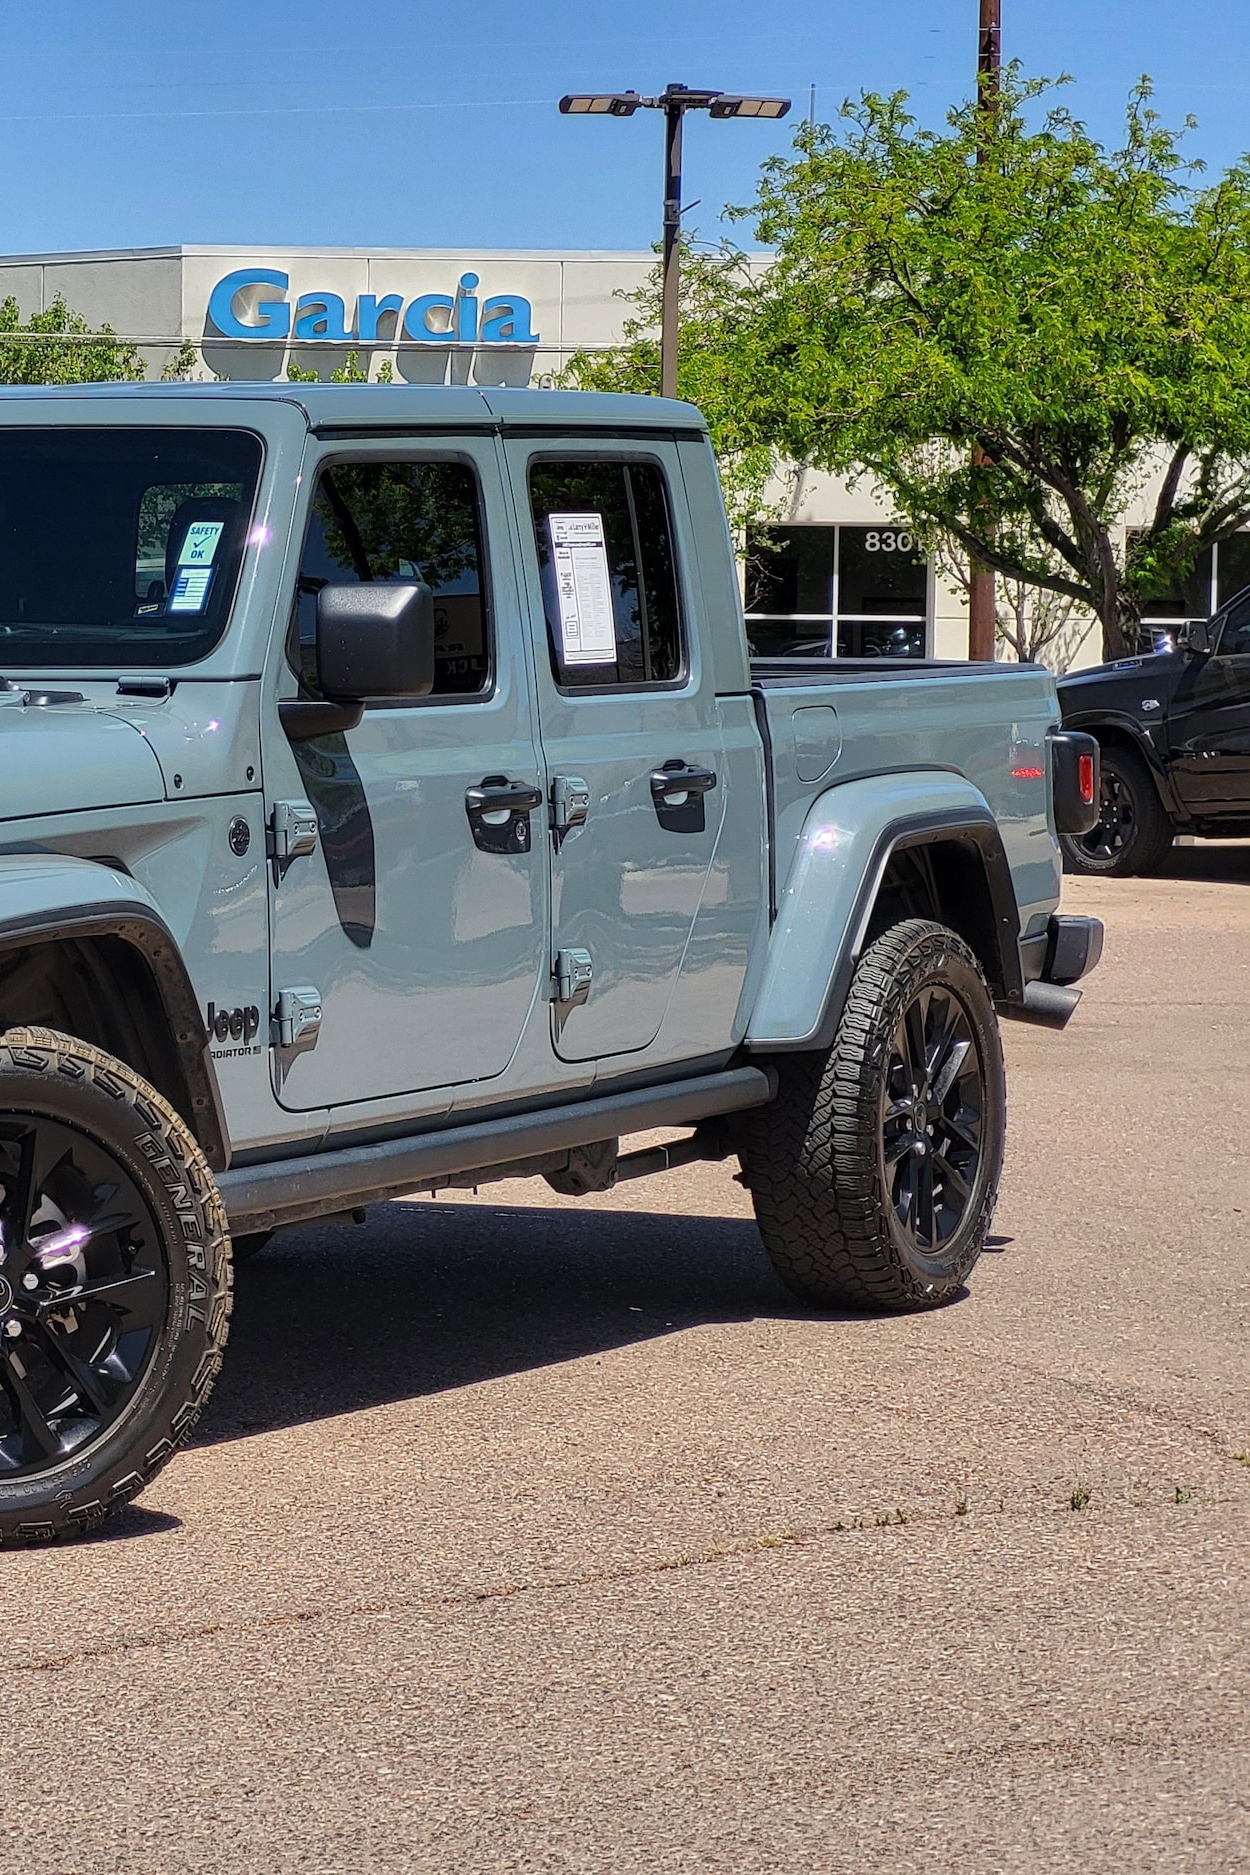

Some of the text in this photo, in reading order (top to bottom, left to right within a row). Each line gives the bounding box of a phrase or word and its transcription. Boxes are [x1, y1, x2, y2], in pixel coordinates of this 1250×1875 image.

[208, 268, 540, 343] Garcia
[190, 526, 220, 536] SAFETY
[190, 549, 205, 560] OK
[210, 1046, 252, 1060] ADIATOR
[134, 1131, 208, 1333] GENERAL
